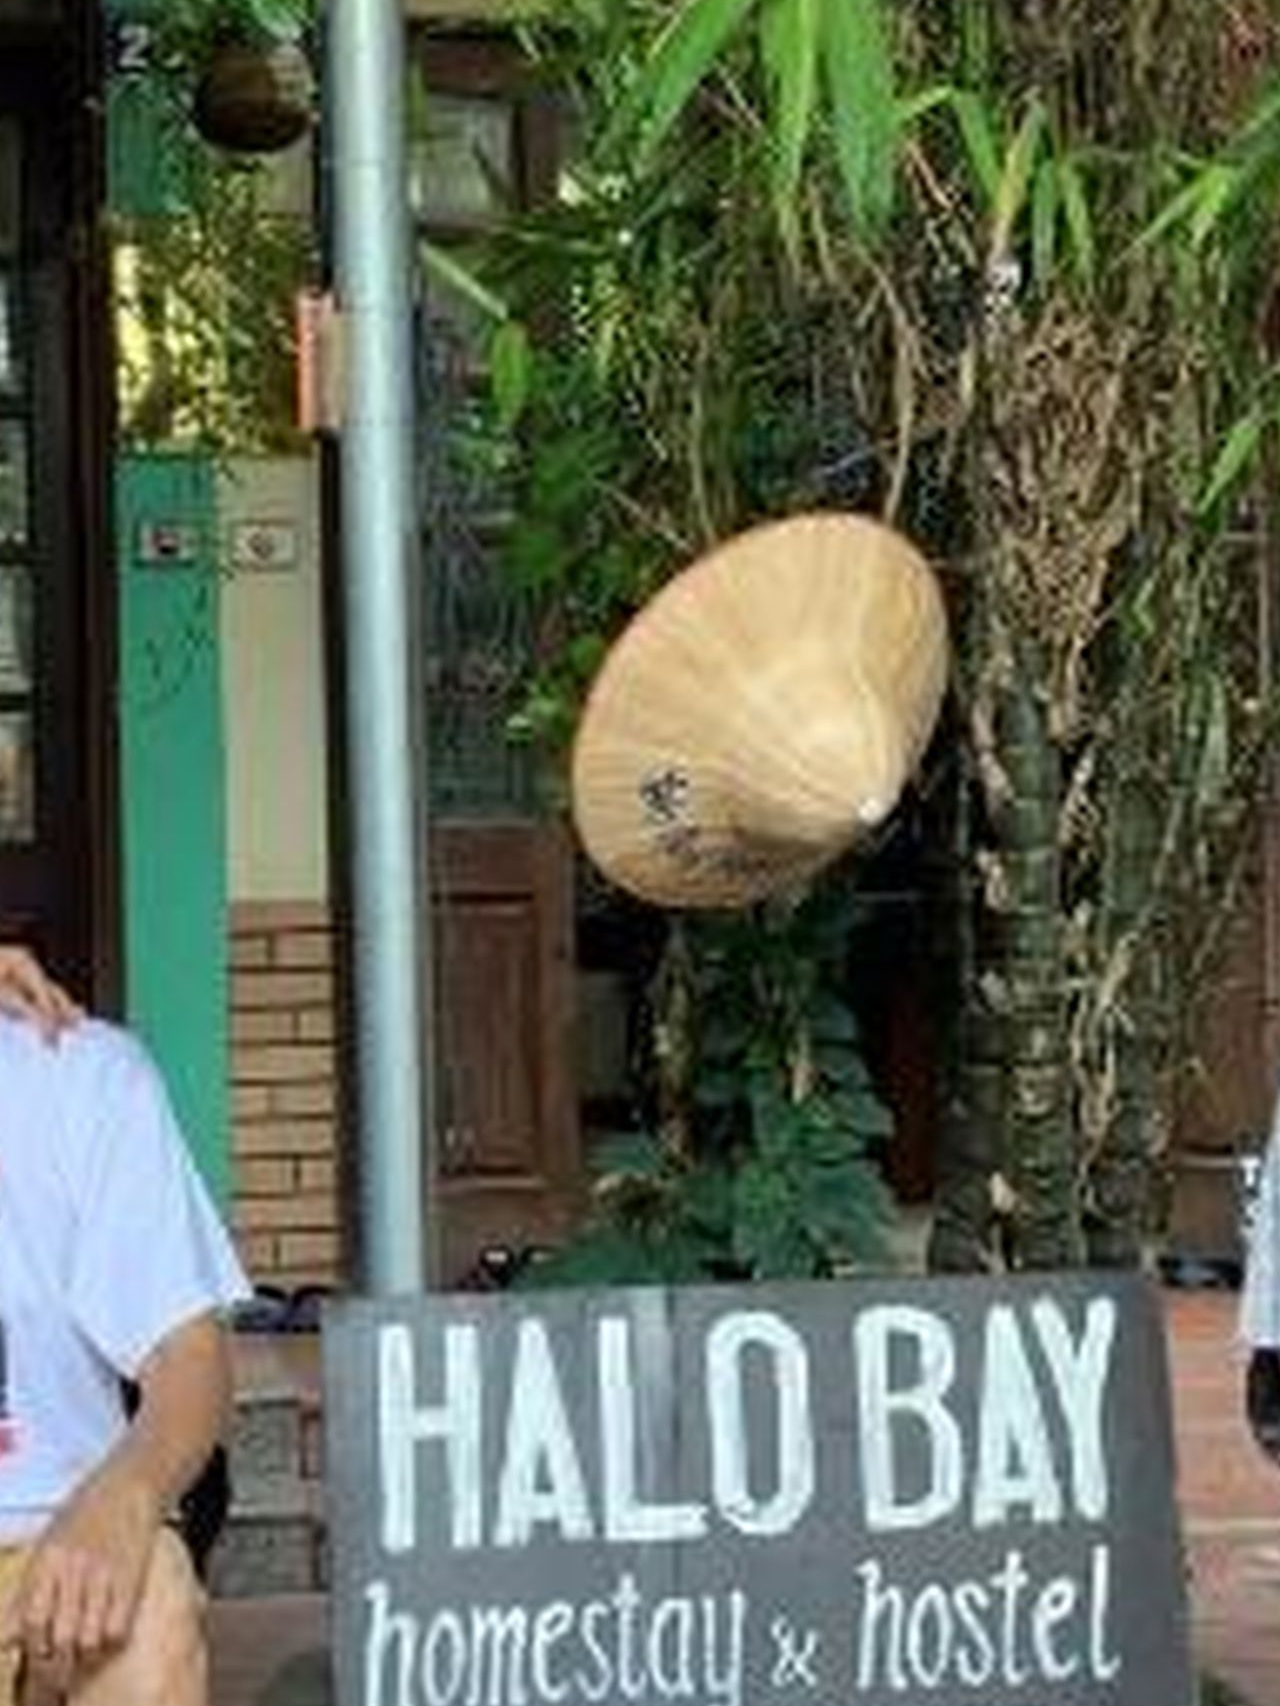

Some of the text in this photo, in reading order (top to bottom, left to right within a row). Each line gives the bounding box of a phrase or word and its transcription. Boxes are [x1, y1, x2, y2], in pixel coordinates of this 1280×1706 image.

[378, 1294, 1119, 1555] HALO BAY
[854, 1543, 1121, 1690] hostel
